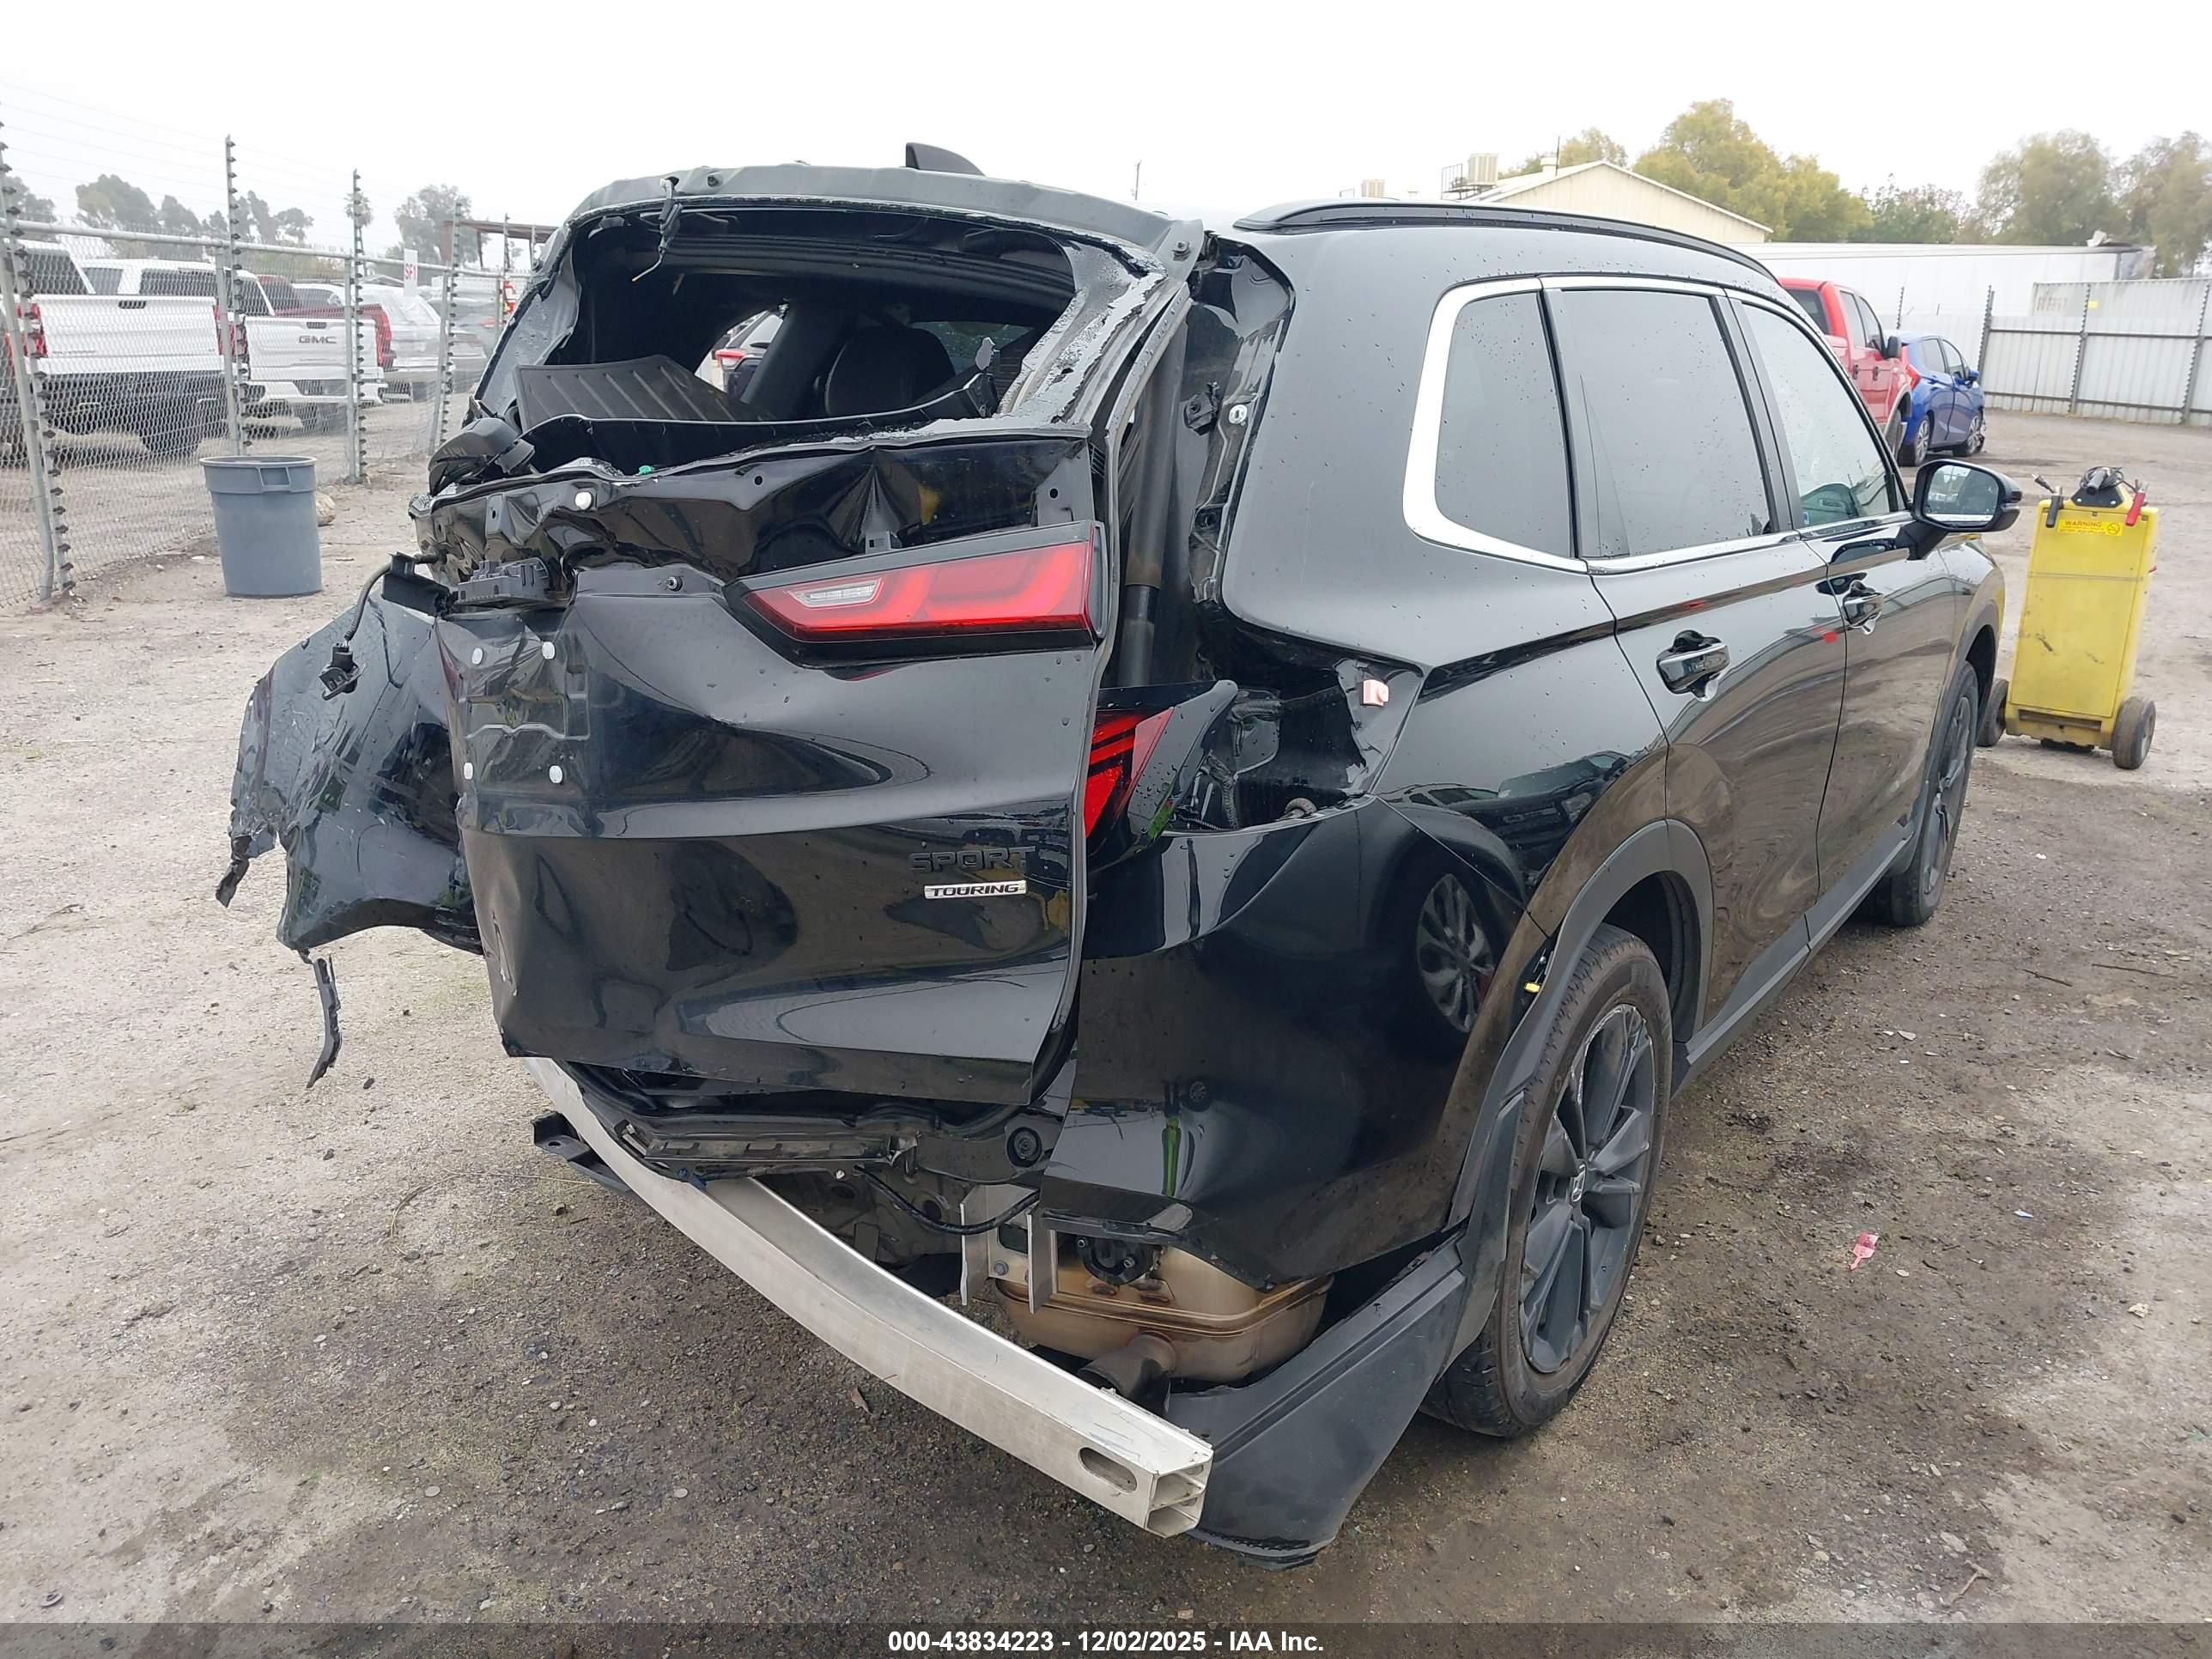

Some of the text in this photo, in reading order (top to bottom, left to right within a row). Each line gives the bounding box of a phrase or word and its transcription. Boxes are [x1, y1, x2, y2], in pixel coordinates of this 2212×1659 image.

[298, 335, 337, 344] GMC
[908, 846, 1036, 872] SPORT
[933, 884, 1018, 897] TOURING
